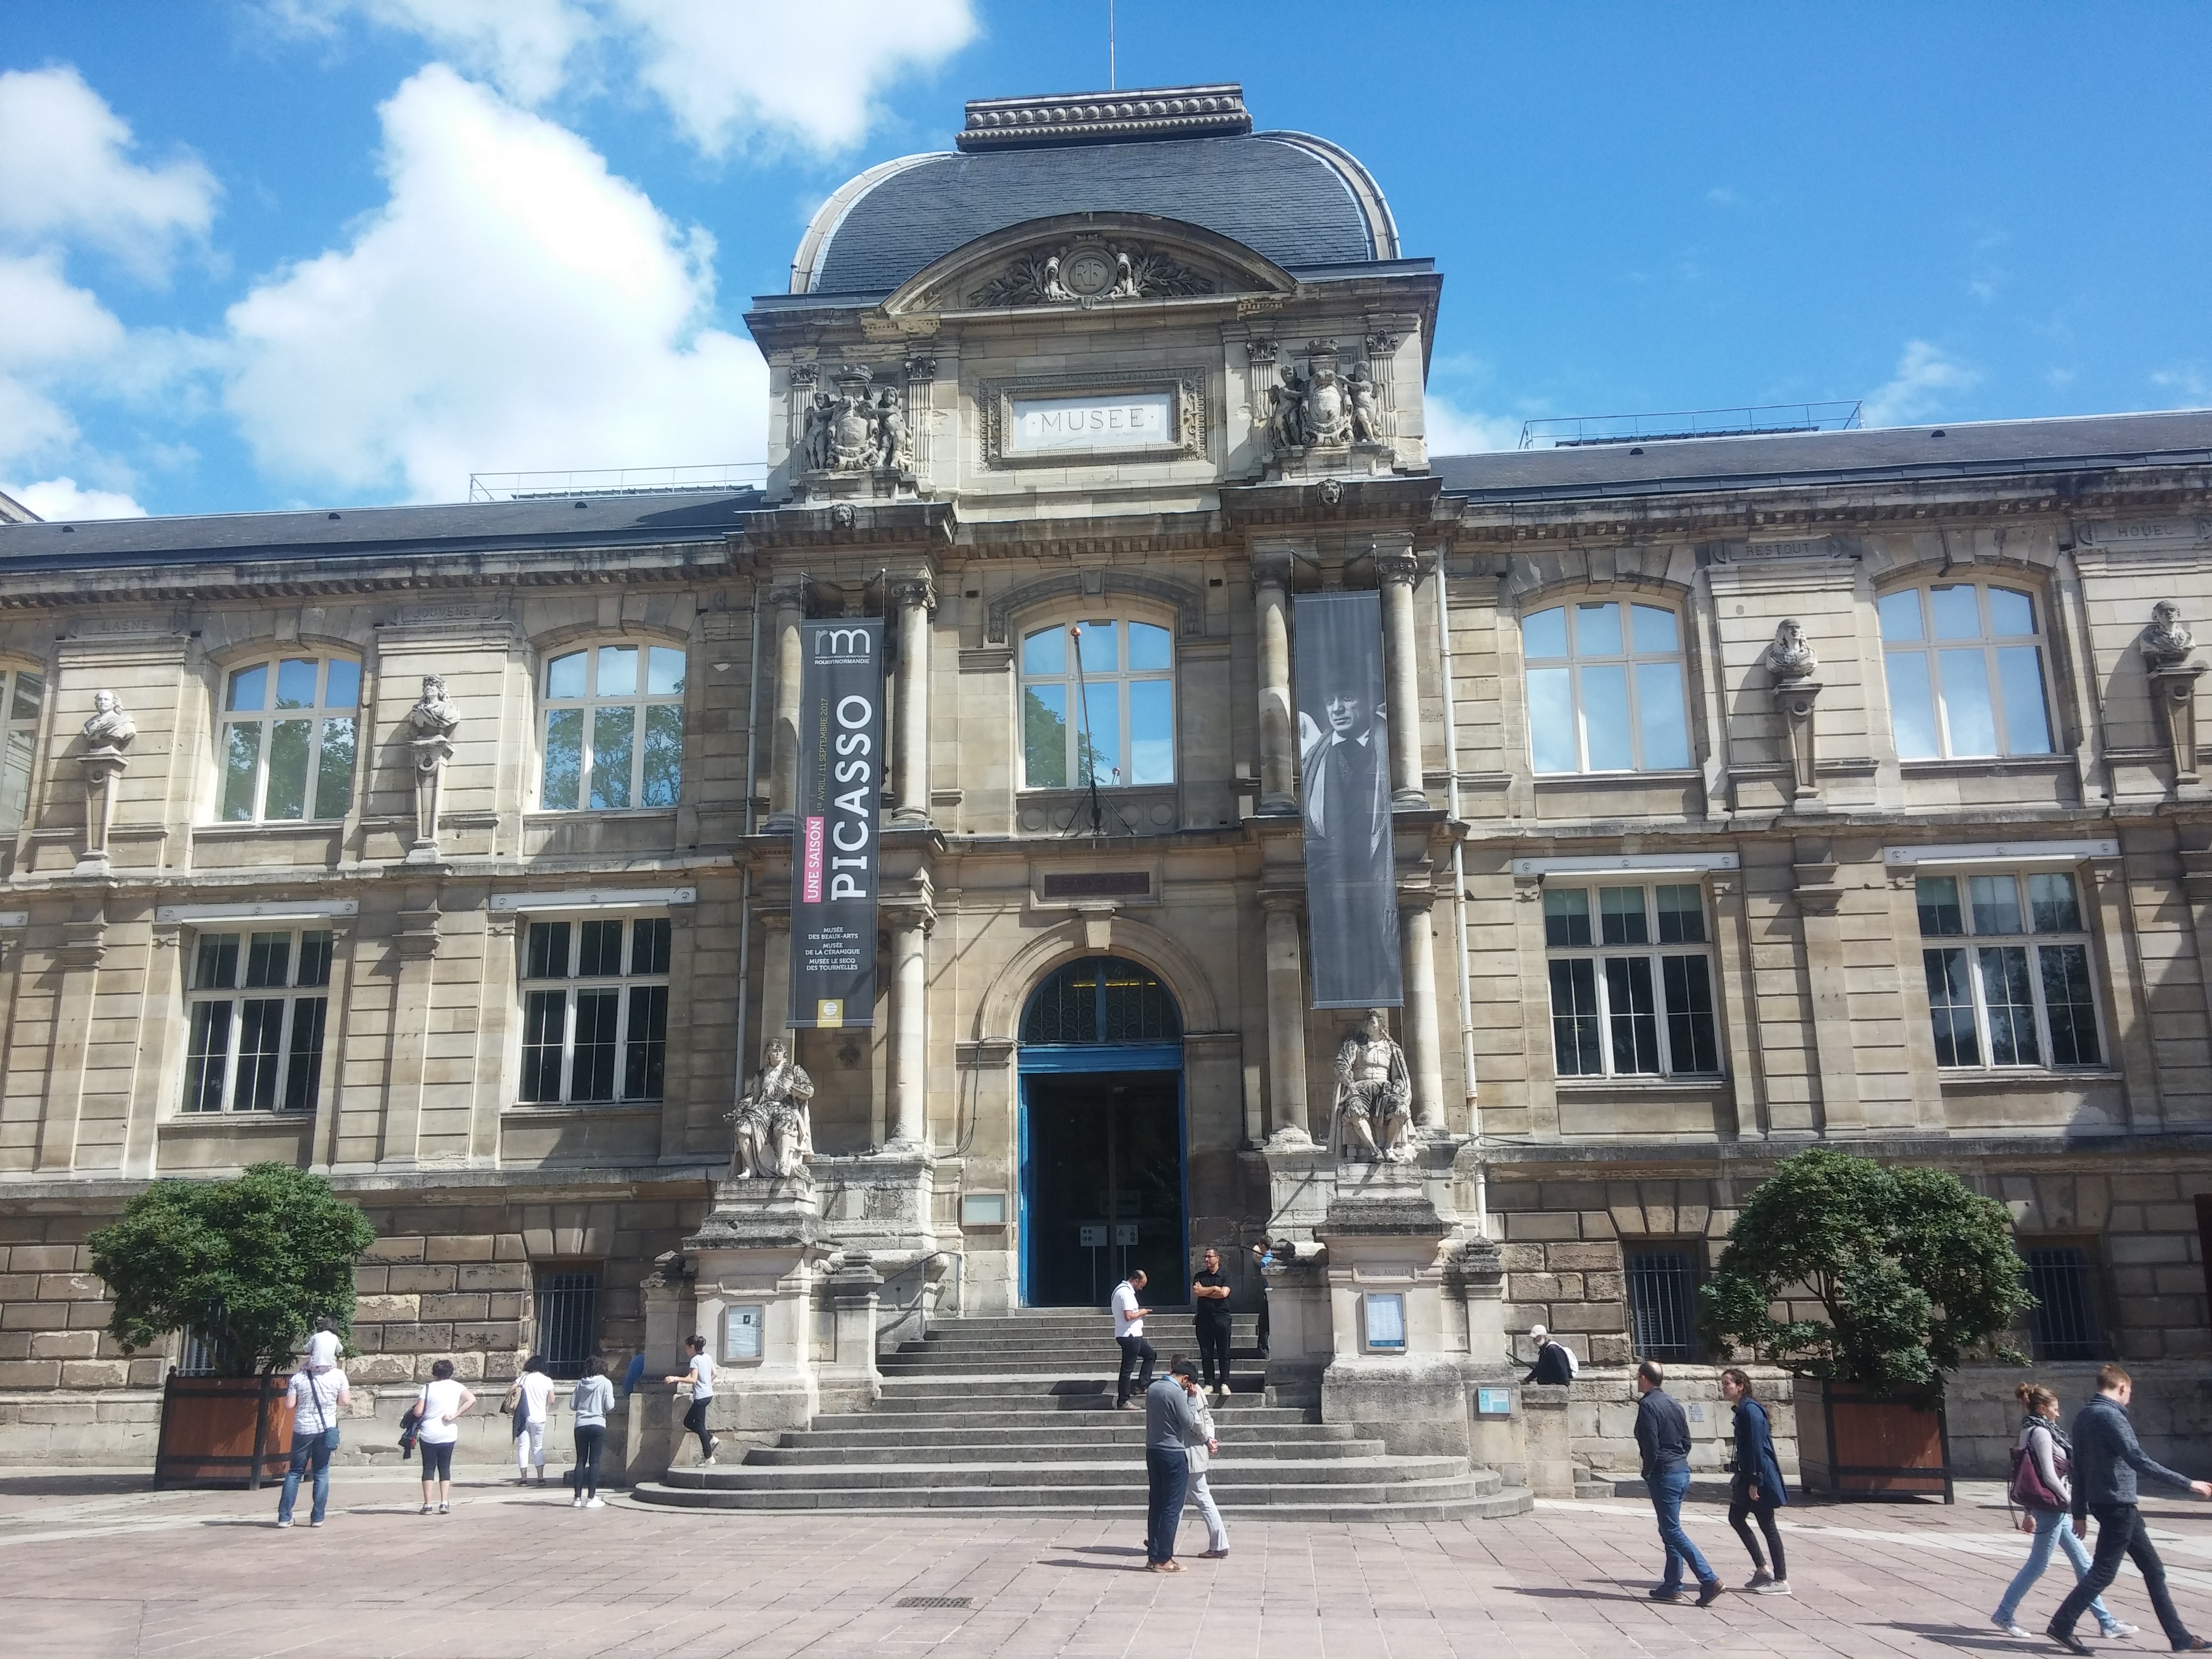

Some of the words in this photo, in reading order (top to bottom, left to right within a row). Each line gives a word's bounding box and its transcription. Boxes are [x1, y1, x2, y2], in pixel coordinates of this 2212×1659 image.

[1074, 262, 1102, 287] RF
[1041, 408, 1144, 432] MUSEE
[2118, 525, 2174, 537] HOUEL
[1745, 543, 1810, 556] RESTOUT
[413, 606, 479, 618] JOUVENET
[103, 620, 150, 631] LASNE
[819, 718, 827, 763] SEPTEMBRE
[831, 695, 873, 901] PICASSO
[808, 820, 822, 868] SAISON
[807, 871, 819, 899] UNE
